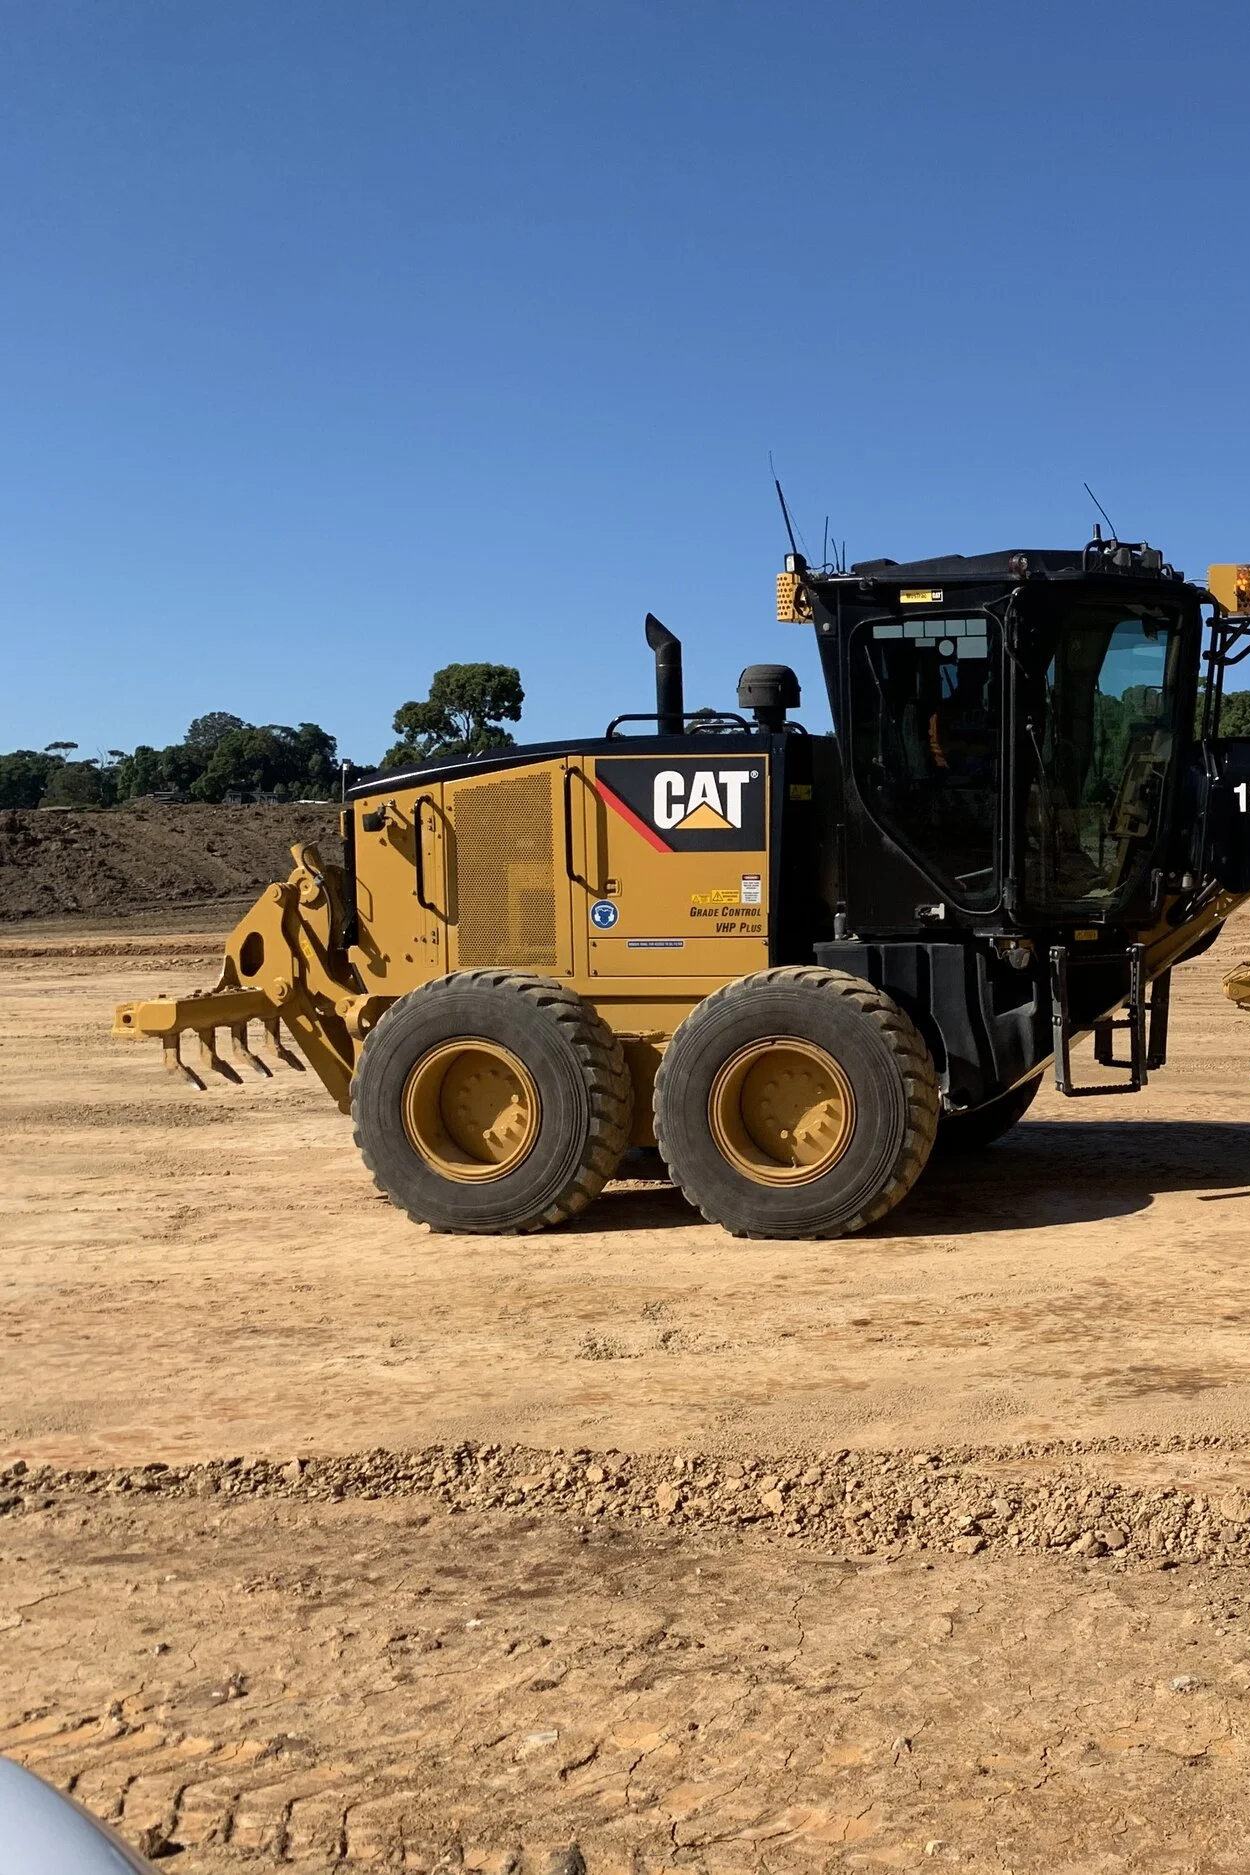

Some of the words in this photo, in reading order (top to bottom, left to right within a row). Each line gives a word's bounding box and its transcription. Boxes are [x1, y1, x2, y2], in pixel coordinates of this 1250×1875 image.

[689, 906, 719, 917] GRADE
[721, 906, 761, 917] CONTROL
[715, 922, 736, 933] VHP
[739, 922, 762, 933] PLUS
